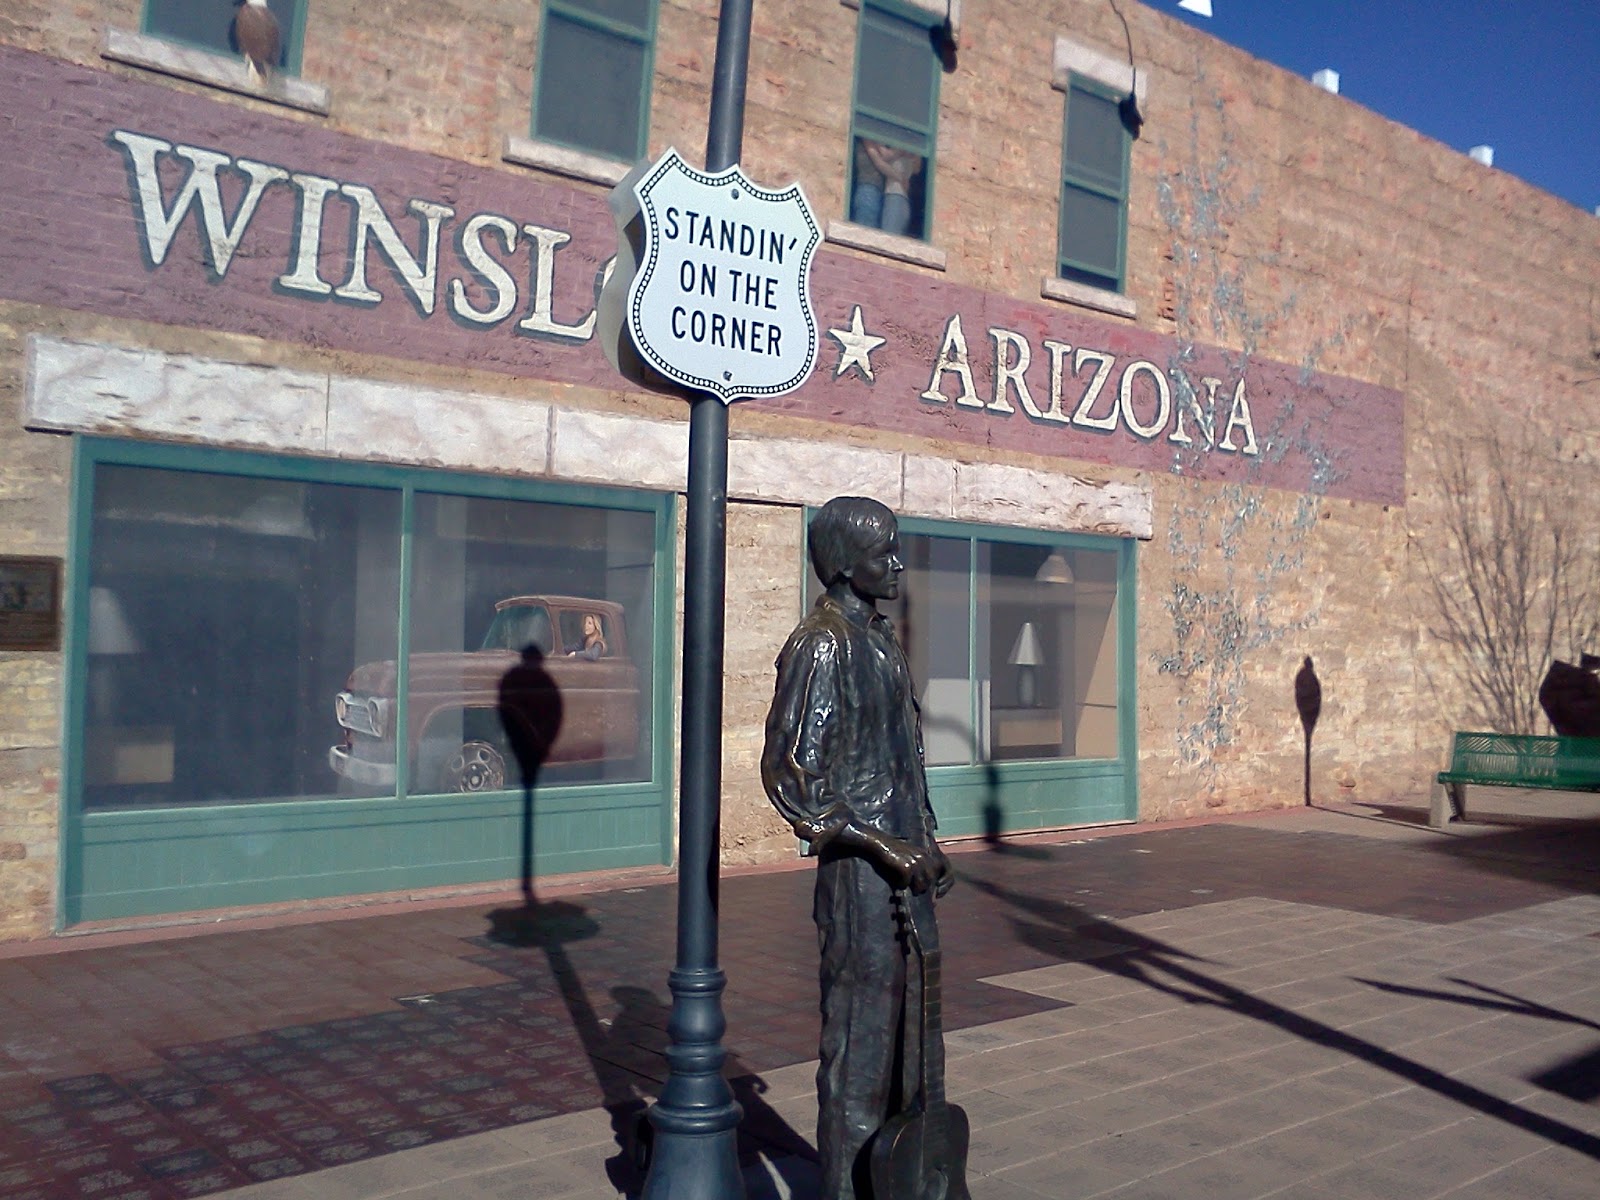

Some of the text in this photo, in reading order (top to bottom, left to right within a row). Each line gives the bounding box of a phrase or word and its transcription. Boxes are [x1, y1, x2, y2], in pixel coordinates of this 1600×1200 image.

[664, 206, 797, 264] STANDIN'
[112, 130, 1259, 455] WINSL ARIZONA
[680, 260, 779, 310] ON THE
[671, 306, 782, 357] CORNER
